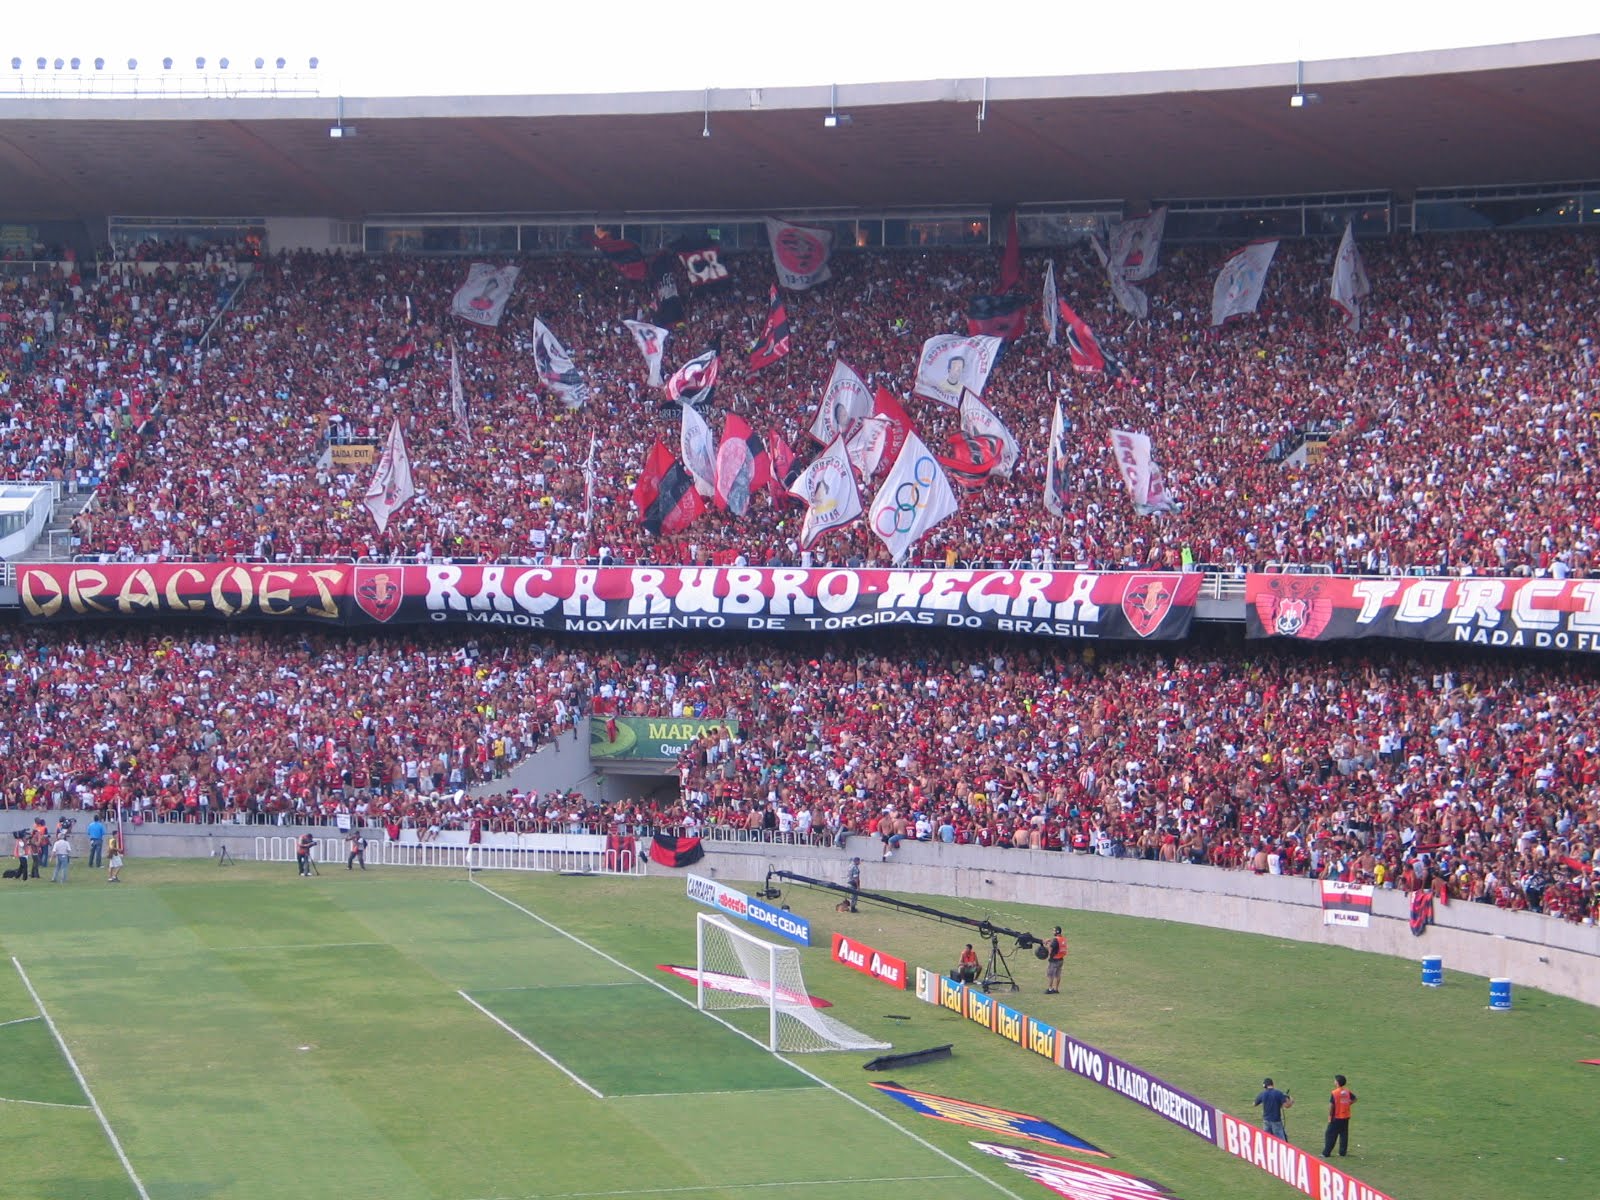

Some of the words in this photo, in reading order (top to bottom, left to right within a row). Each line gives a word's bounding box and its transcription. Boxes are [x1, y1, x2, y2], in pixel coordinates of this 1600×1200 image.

[431, 611, 447, 622] O
[466, 610, 545, 629] MAIOR
[565, 616, 726, 632] MOVIMENTO
[748, 617, 785, 630] DE
[806, 610, 934, 631] TORCIDAS
[946, 613, 982, 628] DO
[998, 620, 1100, 639] BRASIL
[1455, 625, 1524, 646] NADA
[1535, 632, 1569, 648] DO
[660, 743, 682, 756] Que
[748, 904, 778, 927] CEDAE
[778, 916, 808, 940] CEDAE
[940, 978, 962, 1013] Itaú
[969, 991, 991, 1028] Itaú
[998, 1005, 1020, 1044] Itaú
[1029, 1020, 1053, 1059] Itaú
[1068, 1041, 1103, 1081] VIVO
[1107, 1061, 1115, 1088] A
[1116, 1065, 1150, 1106] MAIOR
[1150, 1082, 1212, 1139] COBERTURA
[1225, 1117, 1310, 1194] BRAHMA
